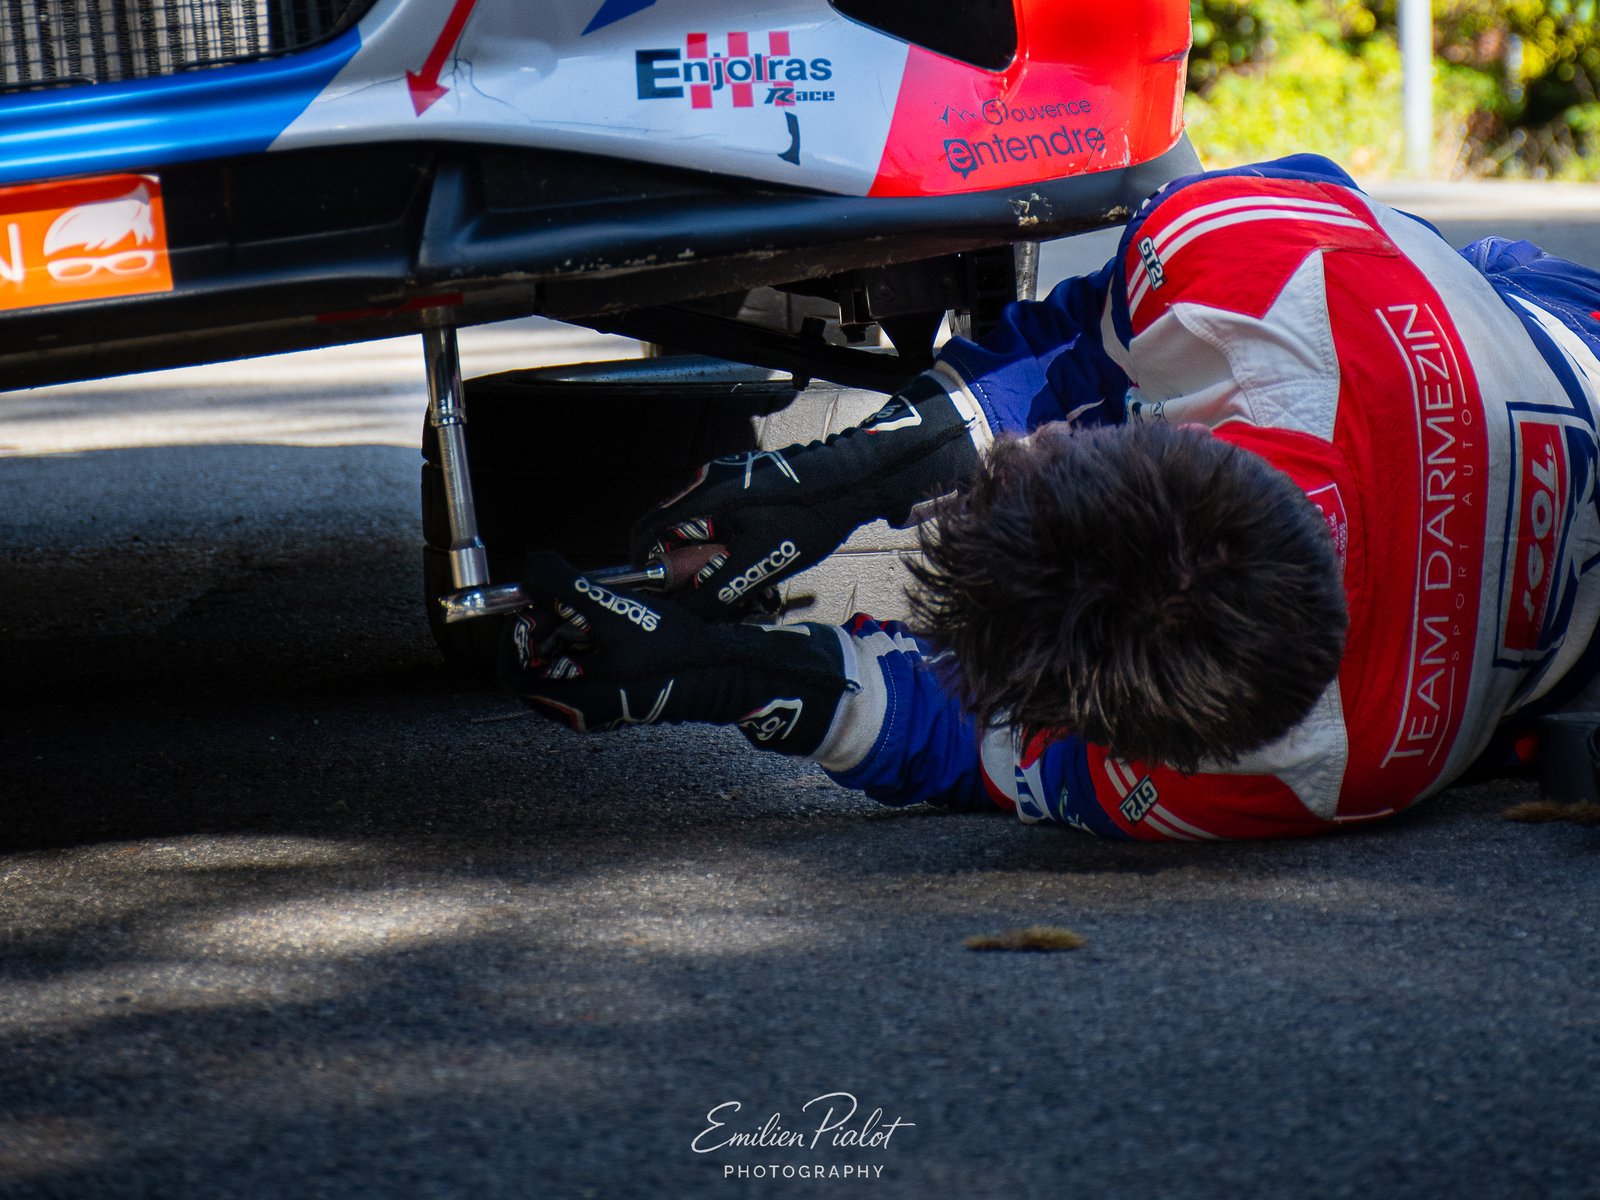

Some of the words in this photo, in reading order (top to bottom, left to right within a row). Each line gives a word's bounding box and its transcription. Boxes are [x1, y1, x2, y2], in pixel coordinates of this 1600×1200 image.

[635, 48, 833, 100] Enjolras
[764, 87, 835, 104] Race
[944, 125, 1106, 175] entendre
[1388, 303, 1458, 591] DARMEZIN
[1451, 542, 1469, 662] SPORT
[1461, 409, 1475, 506] AUTO
[718, 541, 797, 604] sparco
[574, 576, 662, 632] sparco
[1391, 616, 1450, 759] TEAM
